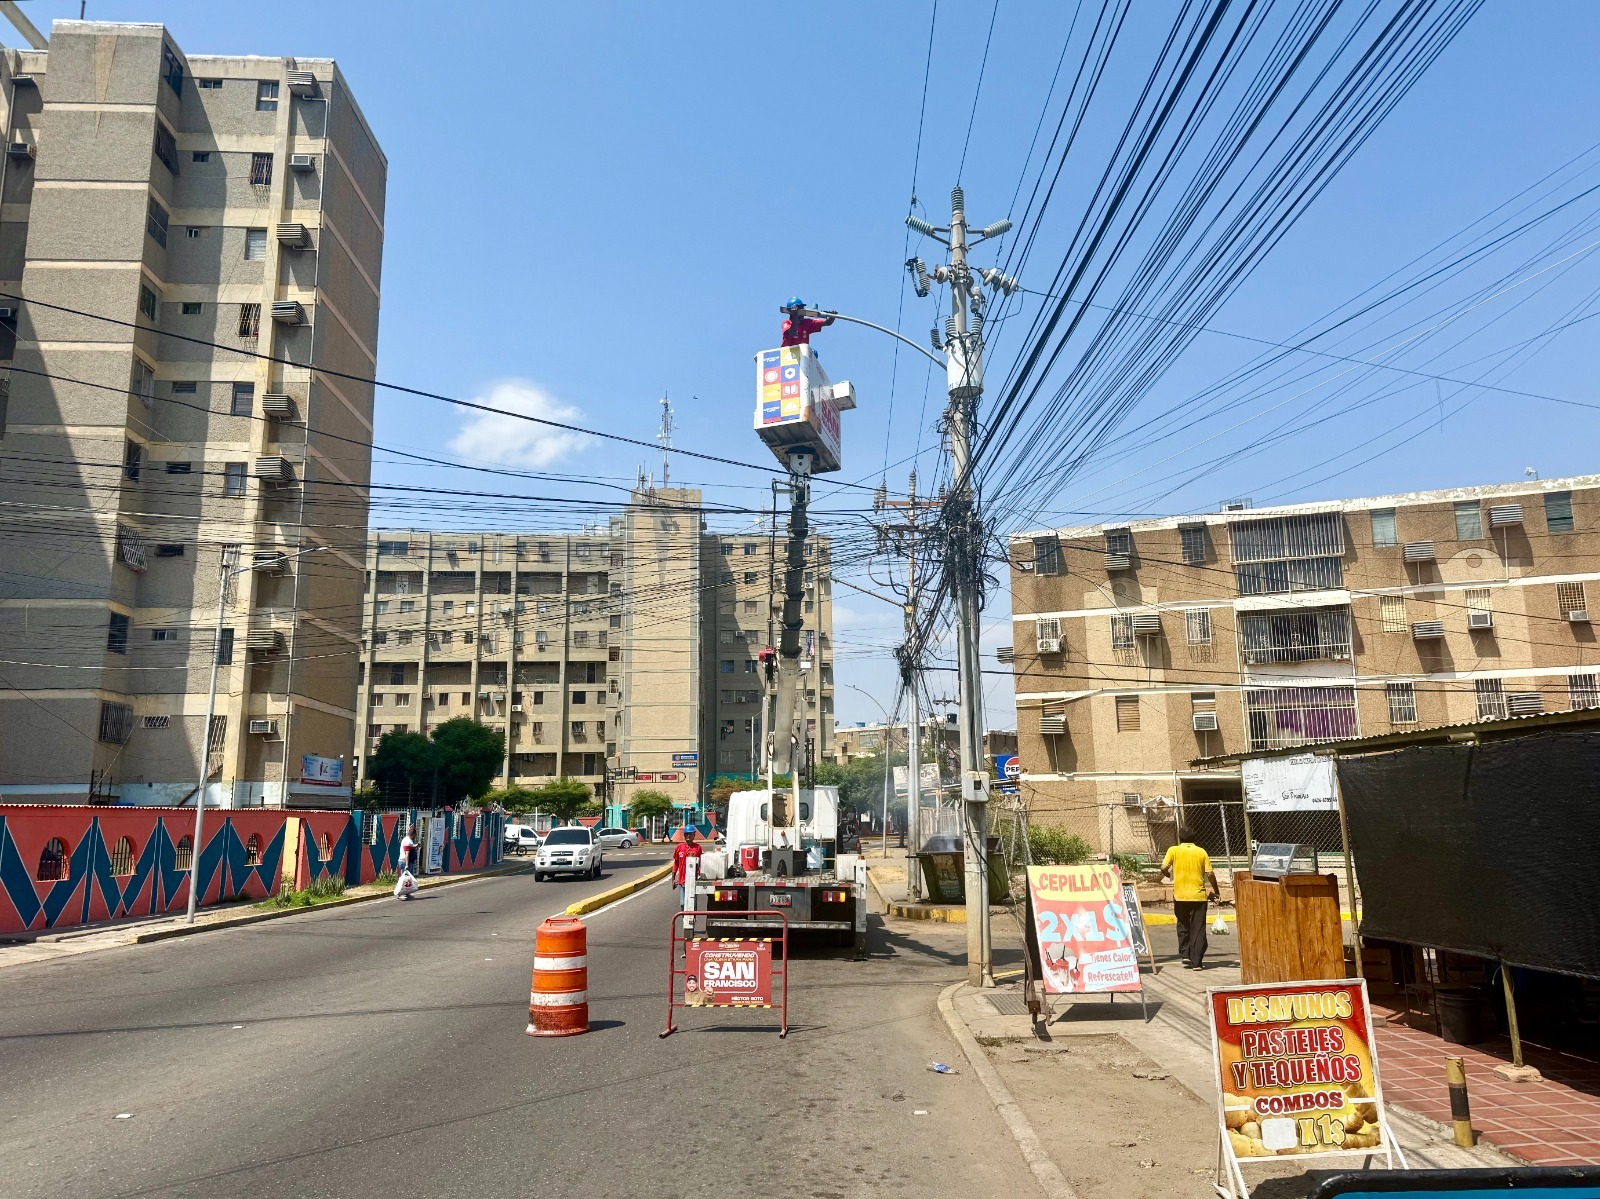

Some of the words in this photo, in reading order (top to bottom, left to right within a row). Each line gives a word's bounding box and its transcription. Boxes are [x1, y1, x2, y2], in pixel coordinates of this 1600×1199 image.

[1039, 871, 1113, 893] CEPILLA'O
[1090, 954, 1112, 964] Tienes
[703, 961, 755, 980] SAN
[1087, 970, 1134, 983] Refrescate!!
[703, 980, 756, 988] FRANCISCO
[1227, 990, 1352, 1025] DESAYUNOS
[1241, 1026, 1345, 1059] PASTELES
[1232, 1061, 1248, 1090] Y
[1250, 1052, 1363, 1089] TEQUEÑOS
[1254, 1090, 1345, 1115] COMBOS
